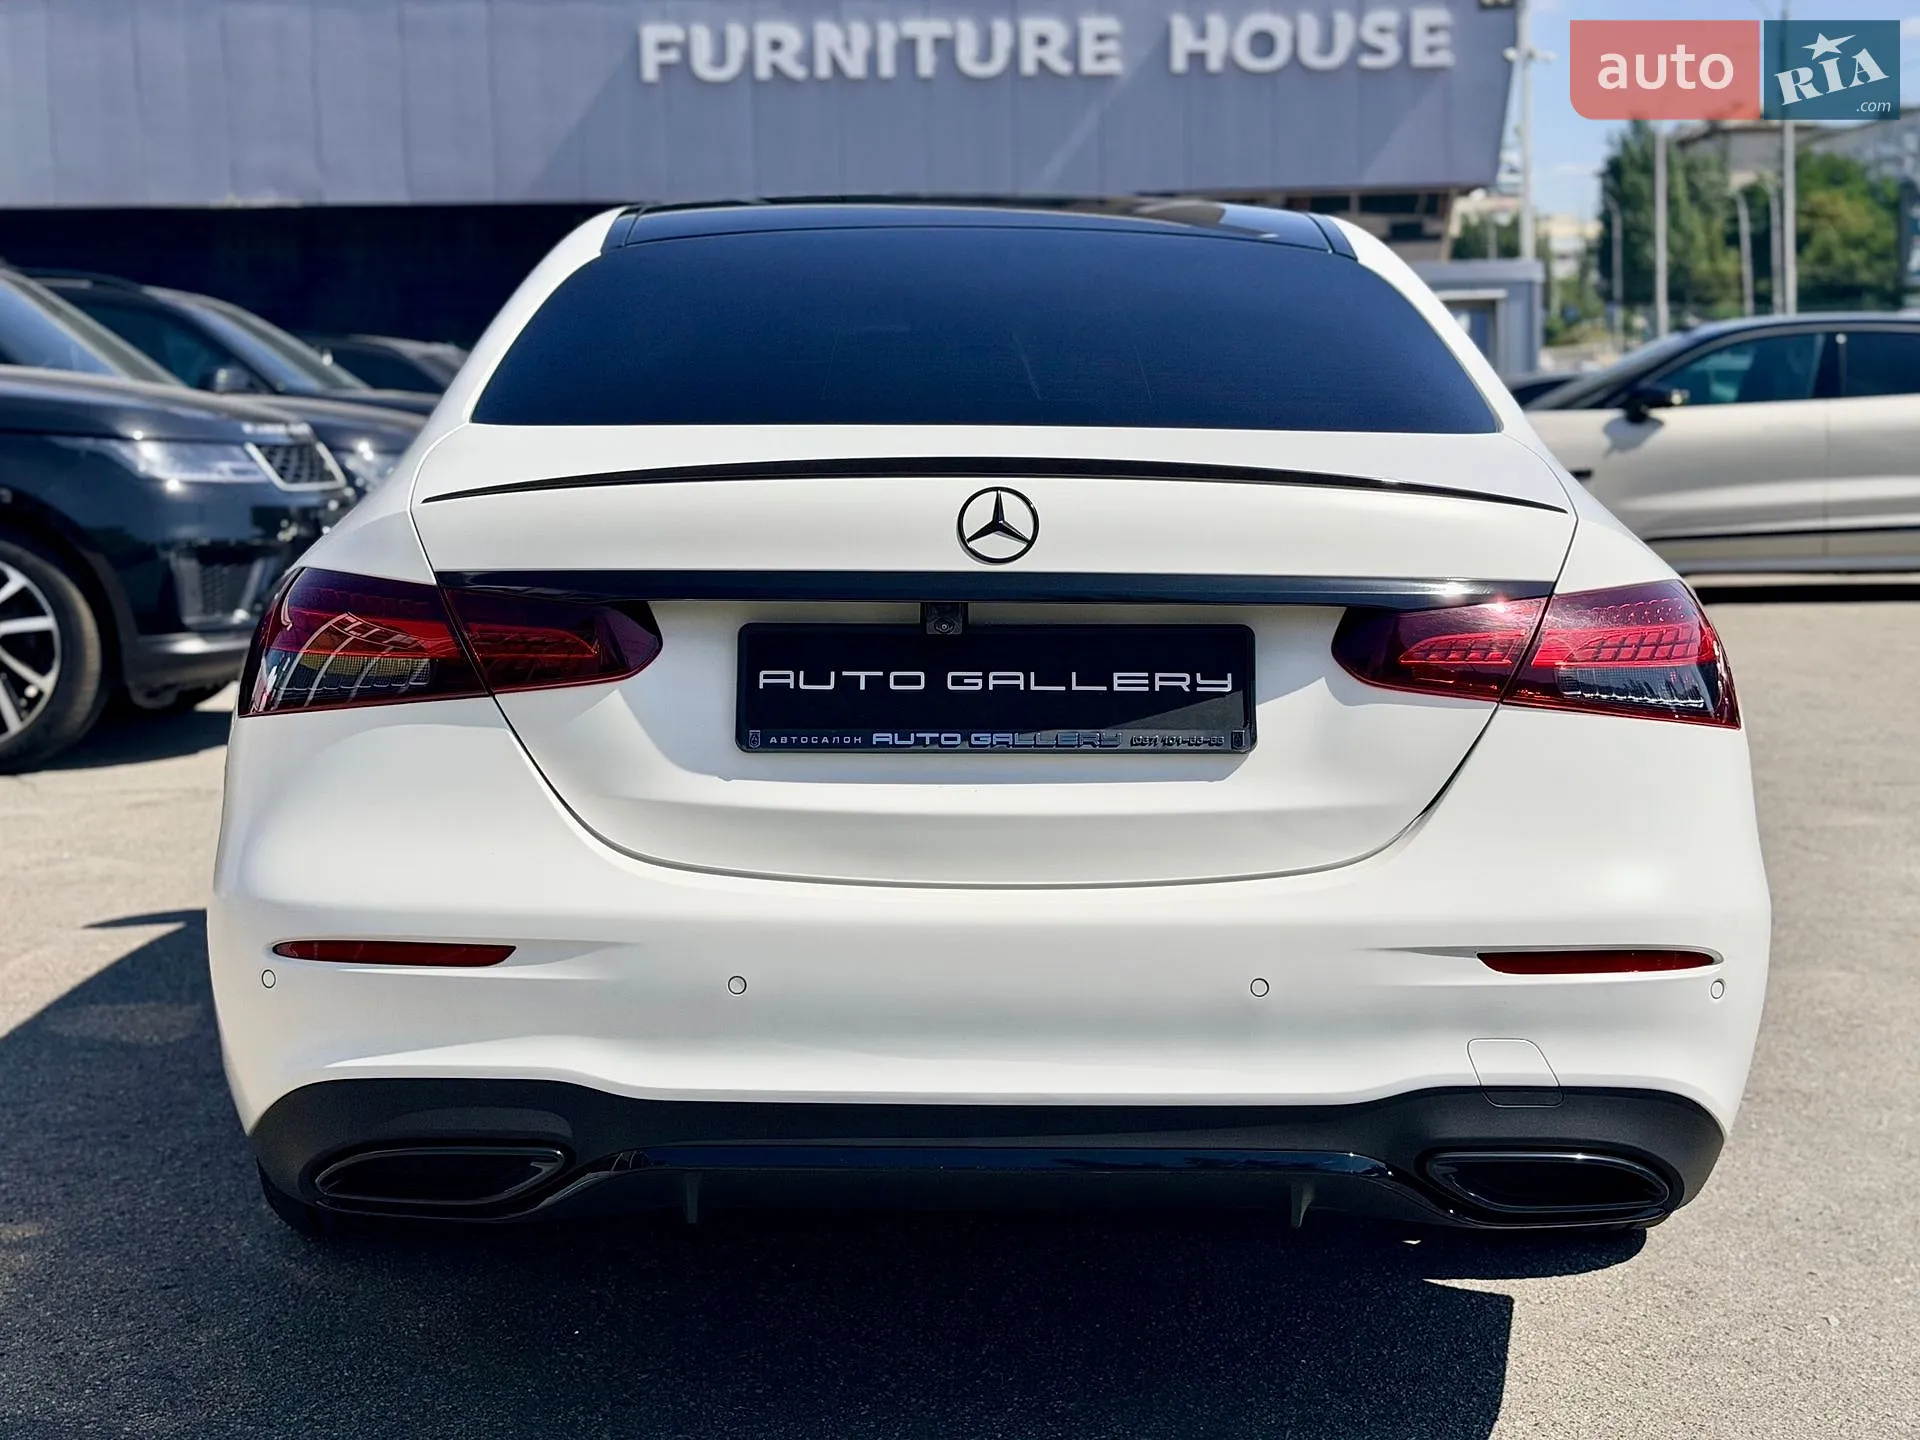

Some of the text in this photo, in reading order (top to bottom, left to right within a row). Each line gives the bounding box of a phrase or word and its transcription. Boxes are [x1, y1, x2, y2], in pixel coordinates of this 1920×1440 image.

[639, 8, 1456, 83] FURNITURE HOUSE
[759, 670, 1232, 692] AUTO GALLERY
[769, 736, 862, 744] АВТОСАЛОН
[872, 732, 961, 746] AUTO
[970, 732, 1122, 746] GALLERY
